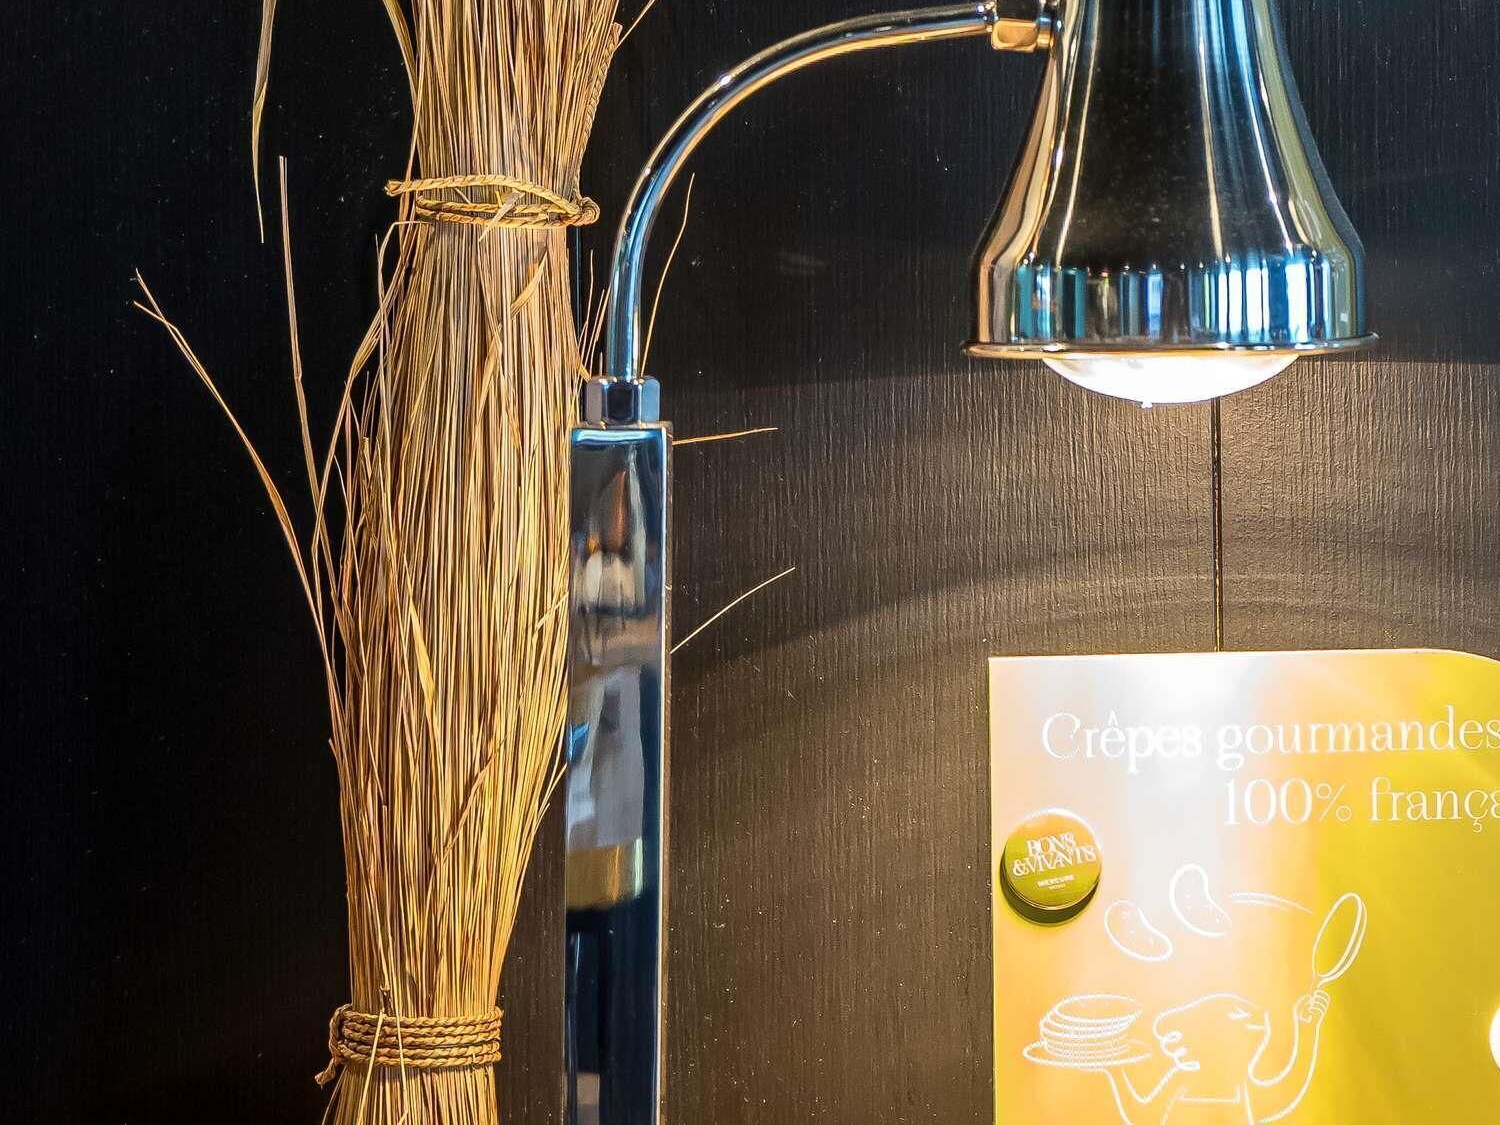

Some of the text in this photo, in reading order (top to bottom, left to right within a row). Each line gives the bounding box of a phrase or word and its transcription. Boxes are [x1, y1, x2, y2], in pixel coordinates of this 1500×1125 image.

[1042, 709, 1201, 772] Crêpes
[1222, 778, 1353, 827] 100%
[1025, 831, 1077, 858] BONS
